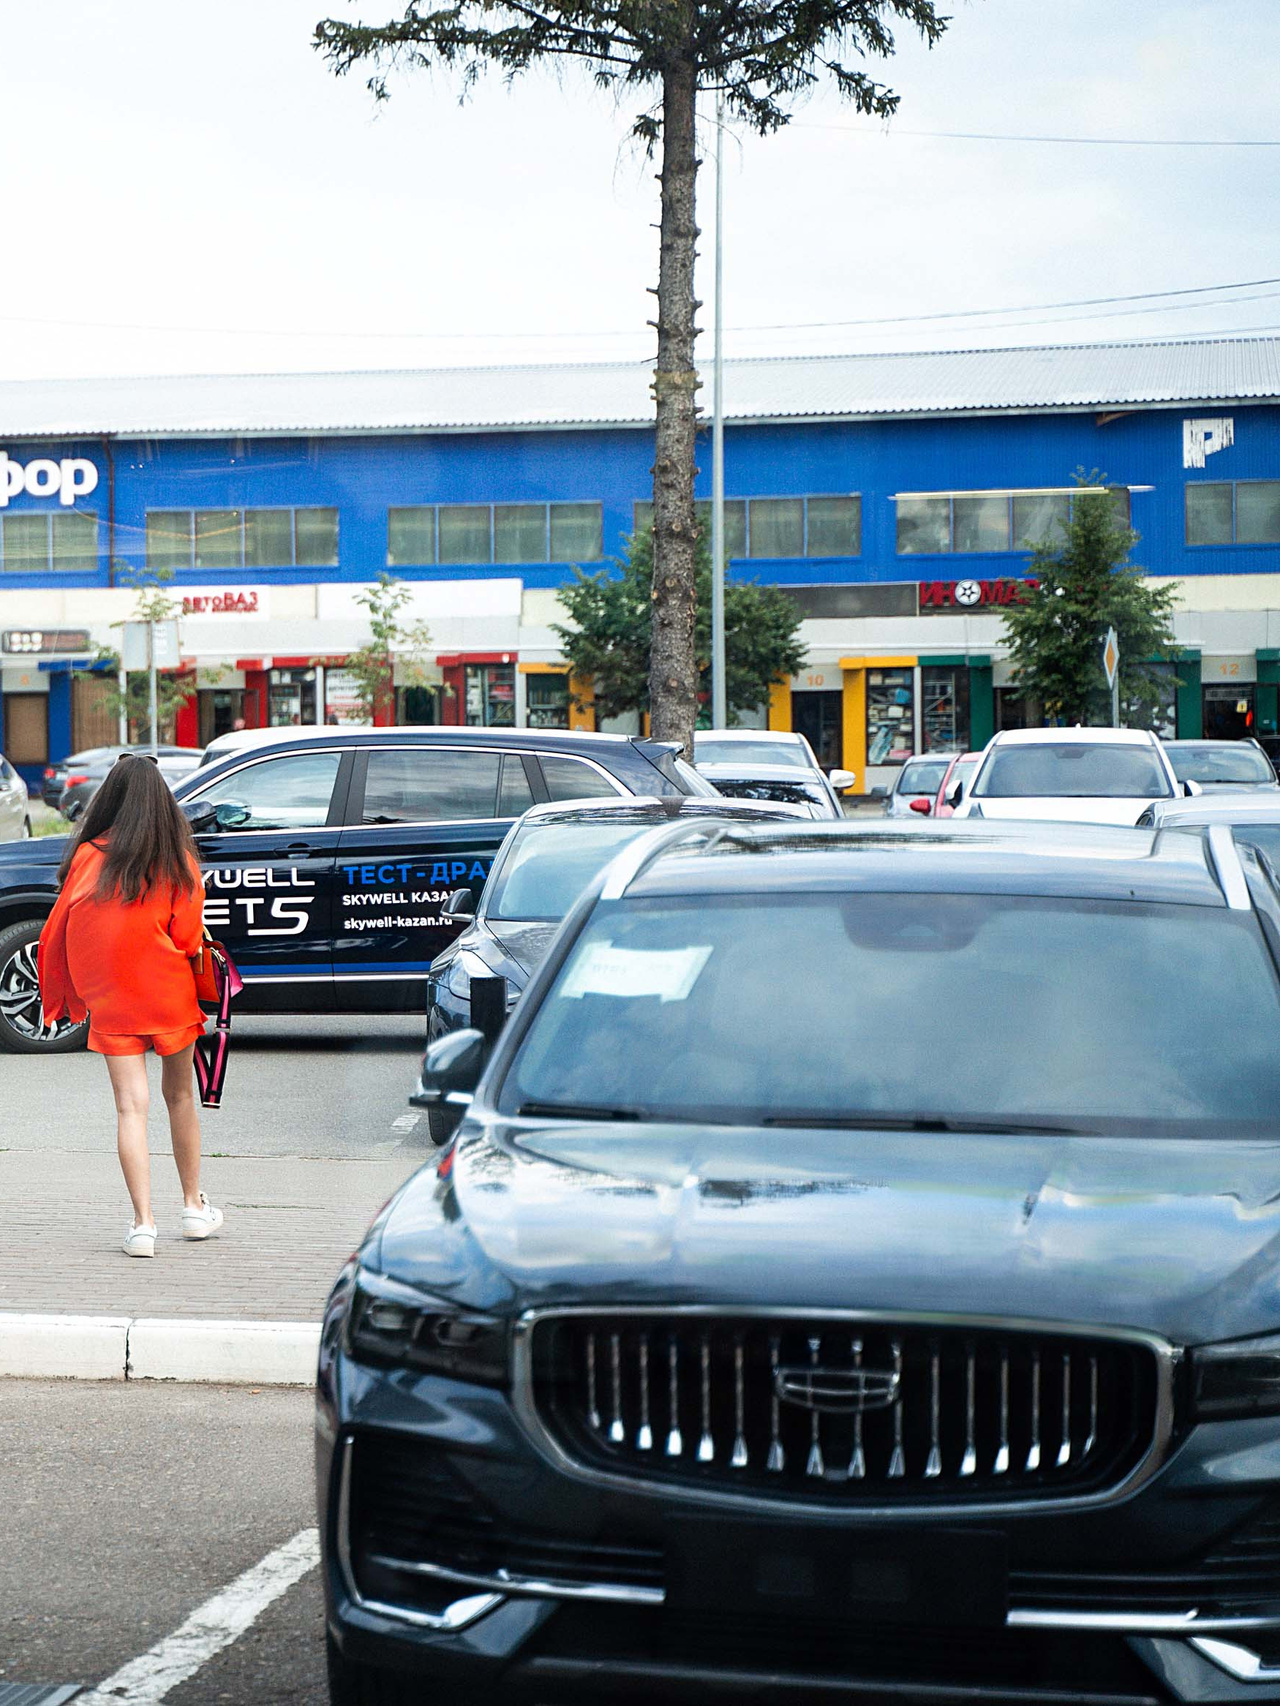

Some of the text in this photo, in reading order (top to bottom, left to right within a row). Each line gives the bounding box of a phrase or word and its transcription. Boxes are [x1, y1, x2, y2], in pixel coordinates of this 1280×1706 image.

[1220, 663, 1240, 675] 12
[807, 674, 825, 687] 10
[343, 857, 496, 885] ТЕСТ-ДРА
[342, 890, 455, 906] SKYWELL КАЗА
[202, 896, 315, 936] ET5
[344, 915, 453, 931] skywell-kazan.ru
